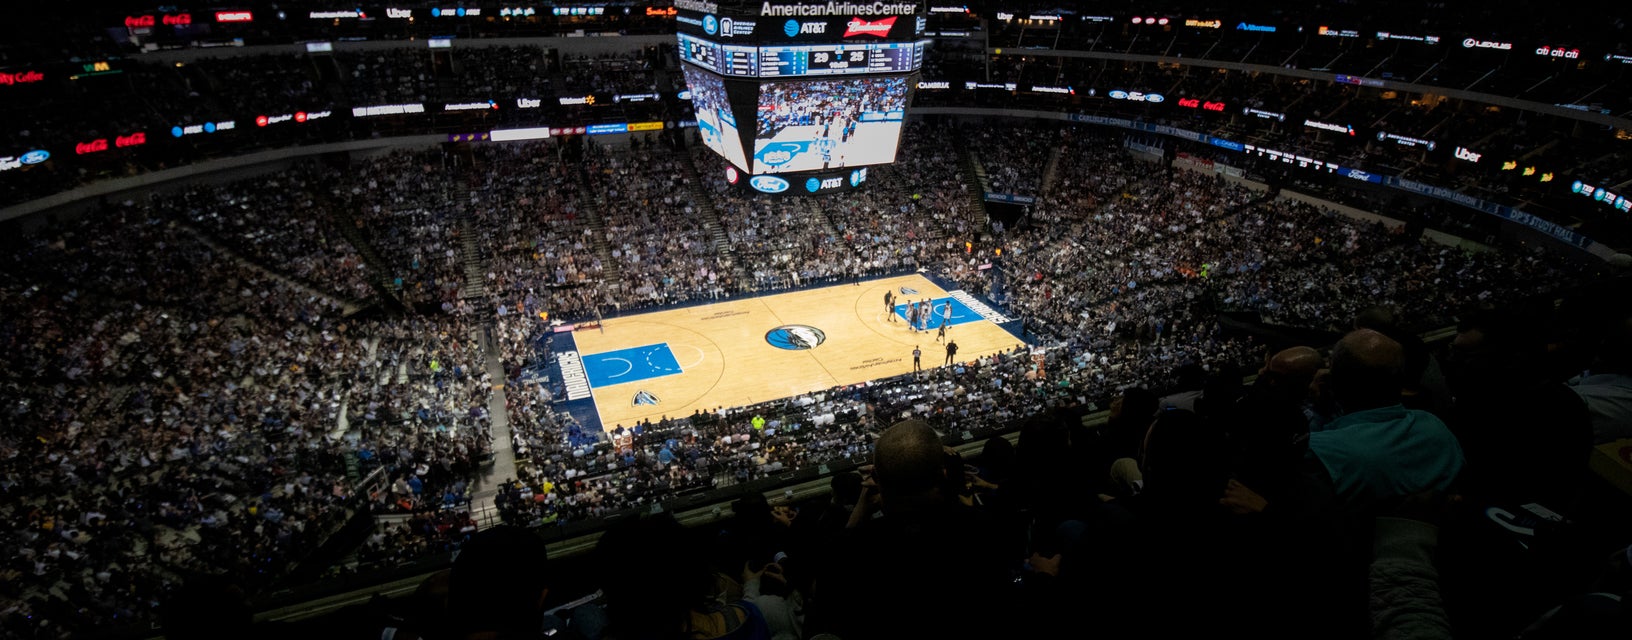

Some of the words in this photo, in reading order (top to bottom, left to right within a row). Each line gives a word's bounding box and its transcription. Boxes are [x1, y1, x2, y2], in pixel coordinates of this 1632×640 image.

[801, 22, 827, 33] AT&T
[1475, 40, 1511, 49] LEXUS
[517, 98, 541, 108] Uber
[1455, 147, 1481, 162] Uber
[1348, 170, 1370, 181] Ford
[821, 178, 843, 189] AT&T
